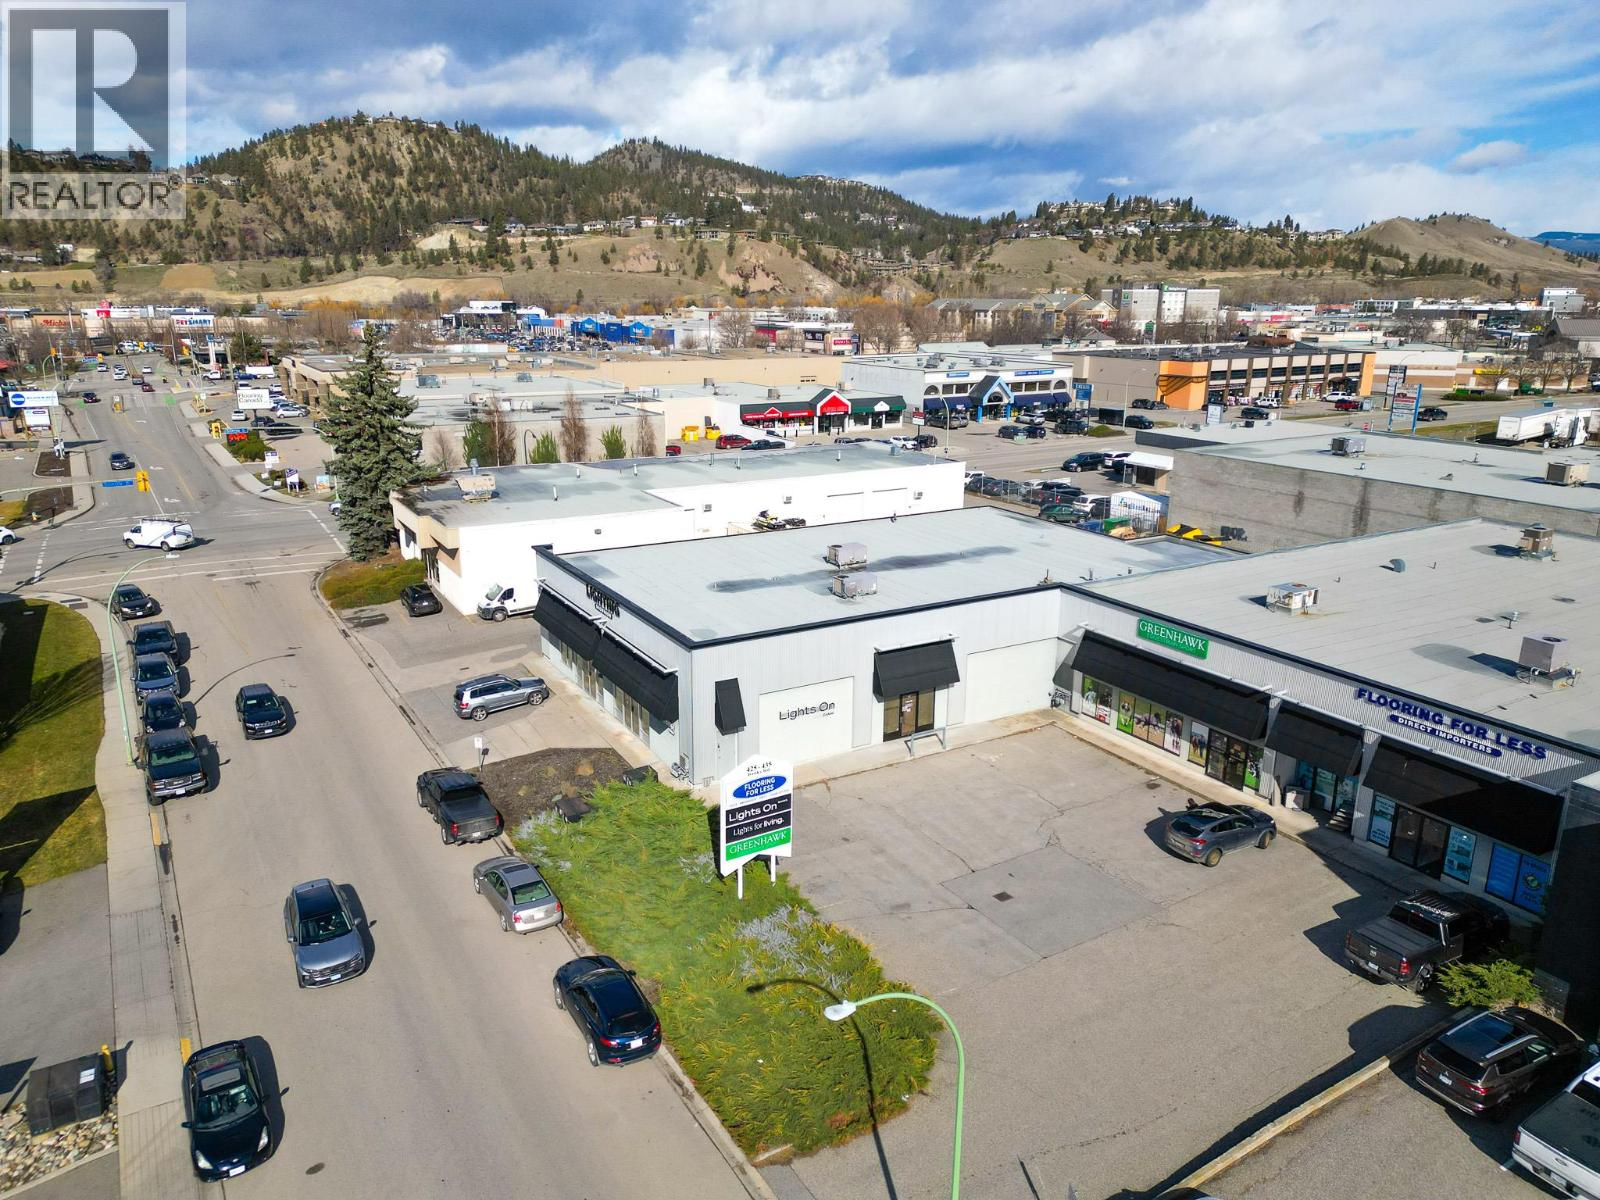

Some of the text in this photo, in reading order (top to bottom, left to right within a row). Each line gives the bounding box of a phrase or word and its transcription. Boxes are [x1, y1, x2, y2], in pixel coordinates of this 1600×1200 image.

[1139, 620, 1206, 651] GREENHAWK
[779, 701, 835, 720] Lights On
[1357, 687, 1547, 760] FLOORING FOR LESS
[1398, 717, 1492, 754] DIRECT IMPORTERS
[744, 777, 775, 790] FLOORING
[746, 784, 775, 797] FOR LESS
[728, 802, 778, 822] Lights On
[733, 824, 753, 836] Lights
[754, 820, 762, 830] for
[729, 830, 787, 854] GREENHAWK
